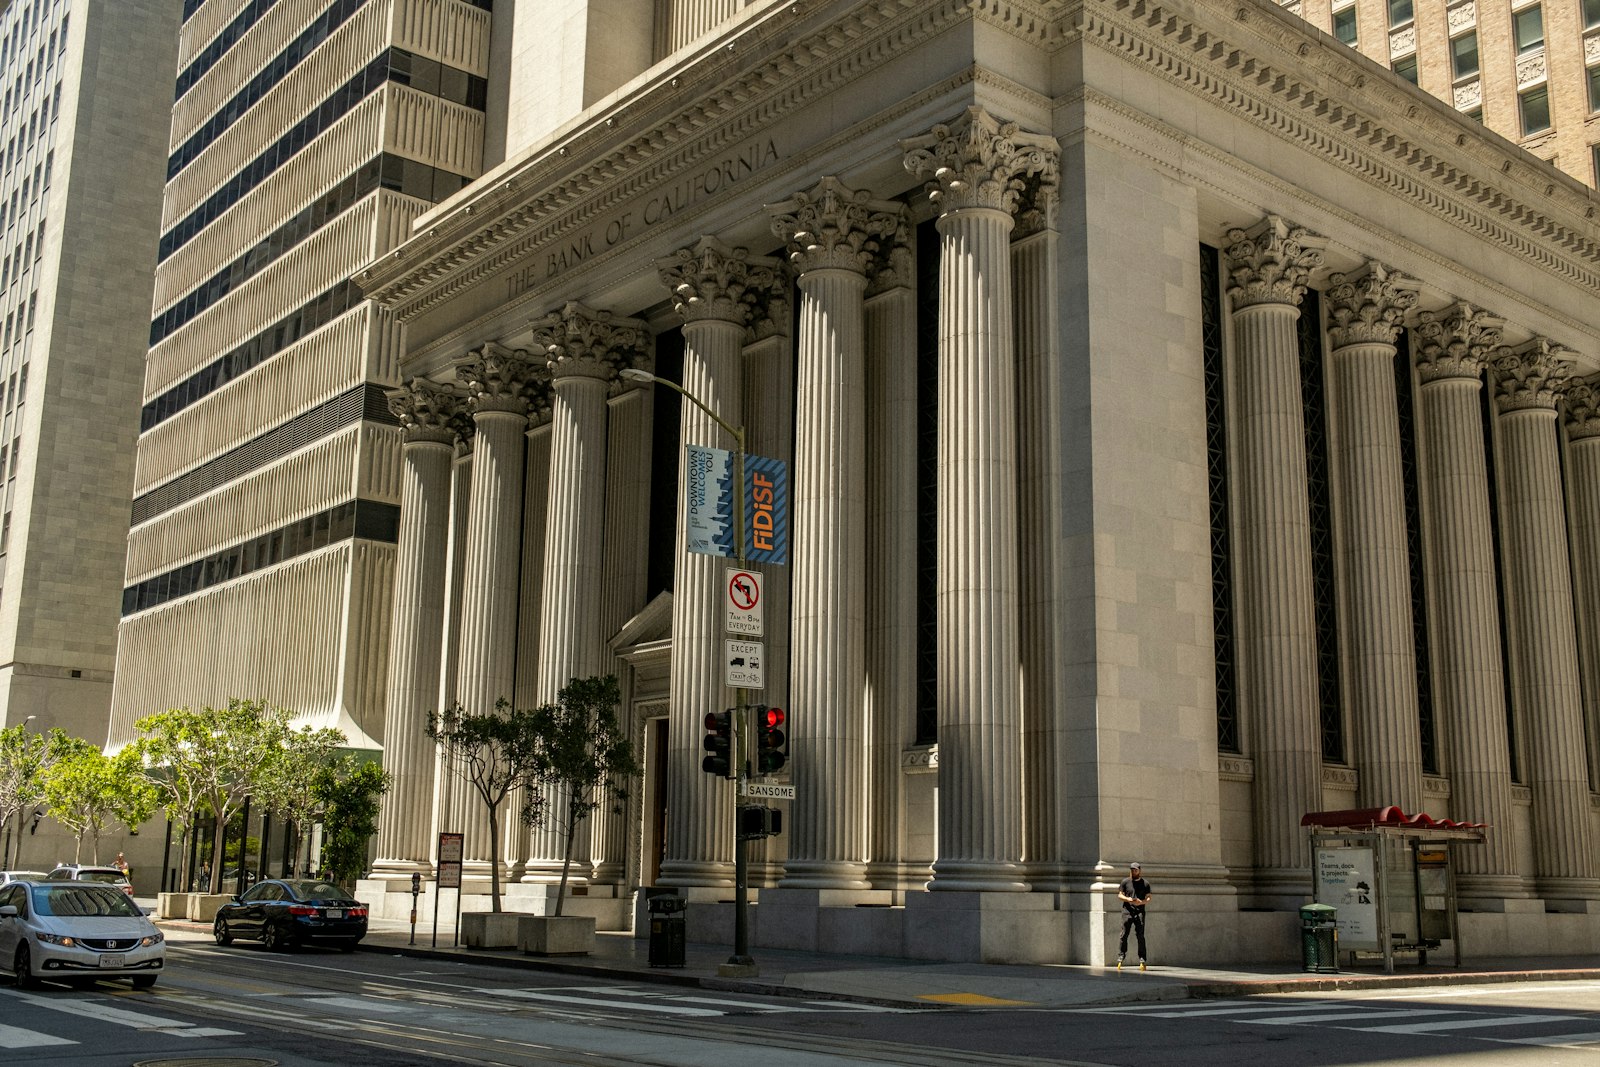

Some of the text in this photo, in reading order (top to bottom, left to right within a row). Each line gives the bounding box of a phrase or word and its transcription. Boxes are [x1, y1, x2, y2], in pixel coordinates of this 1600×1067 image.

[505, 139, 779, 298] THE BANK OF CALIFORNIA
[753, 472, 773, 551] FiDiSF
[729, 611, 741, 620] 7AM
[747, 614, 760, 623] 8PM
[728, 621, 760, 632] EVERYDAY
[731, 644, 758, 654] EXCEPT
[749, 785, 794, 797] SANSOME
